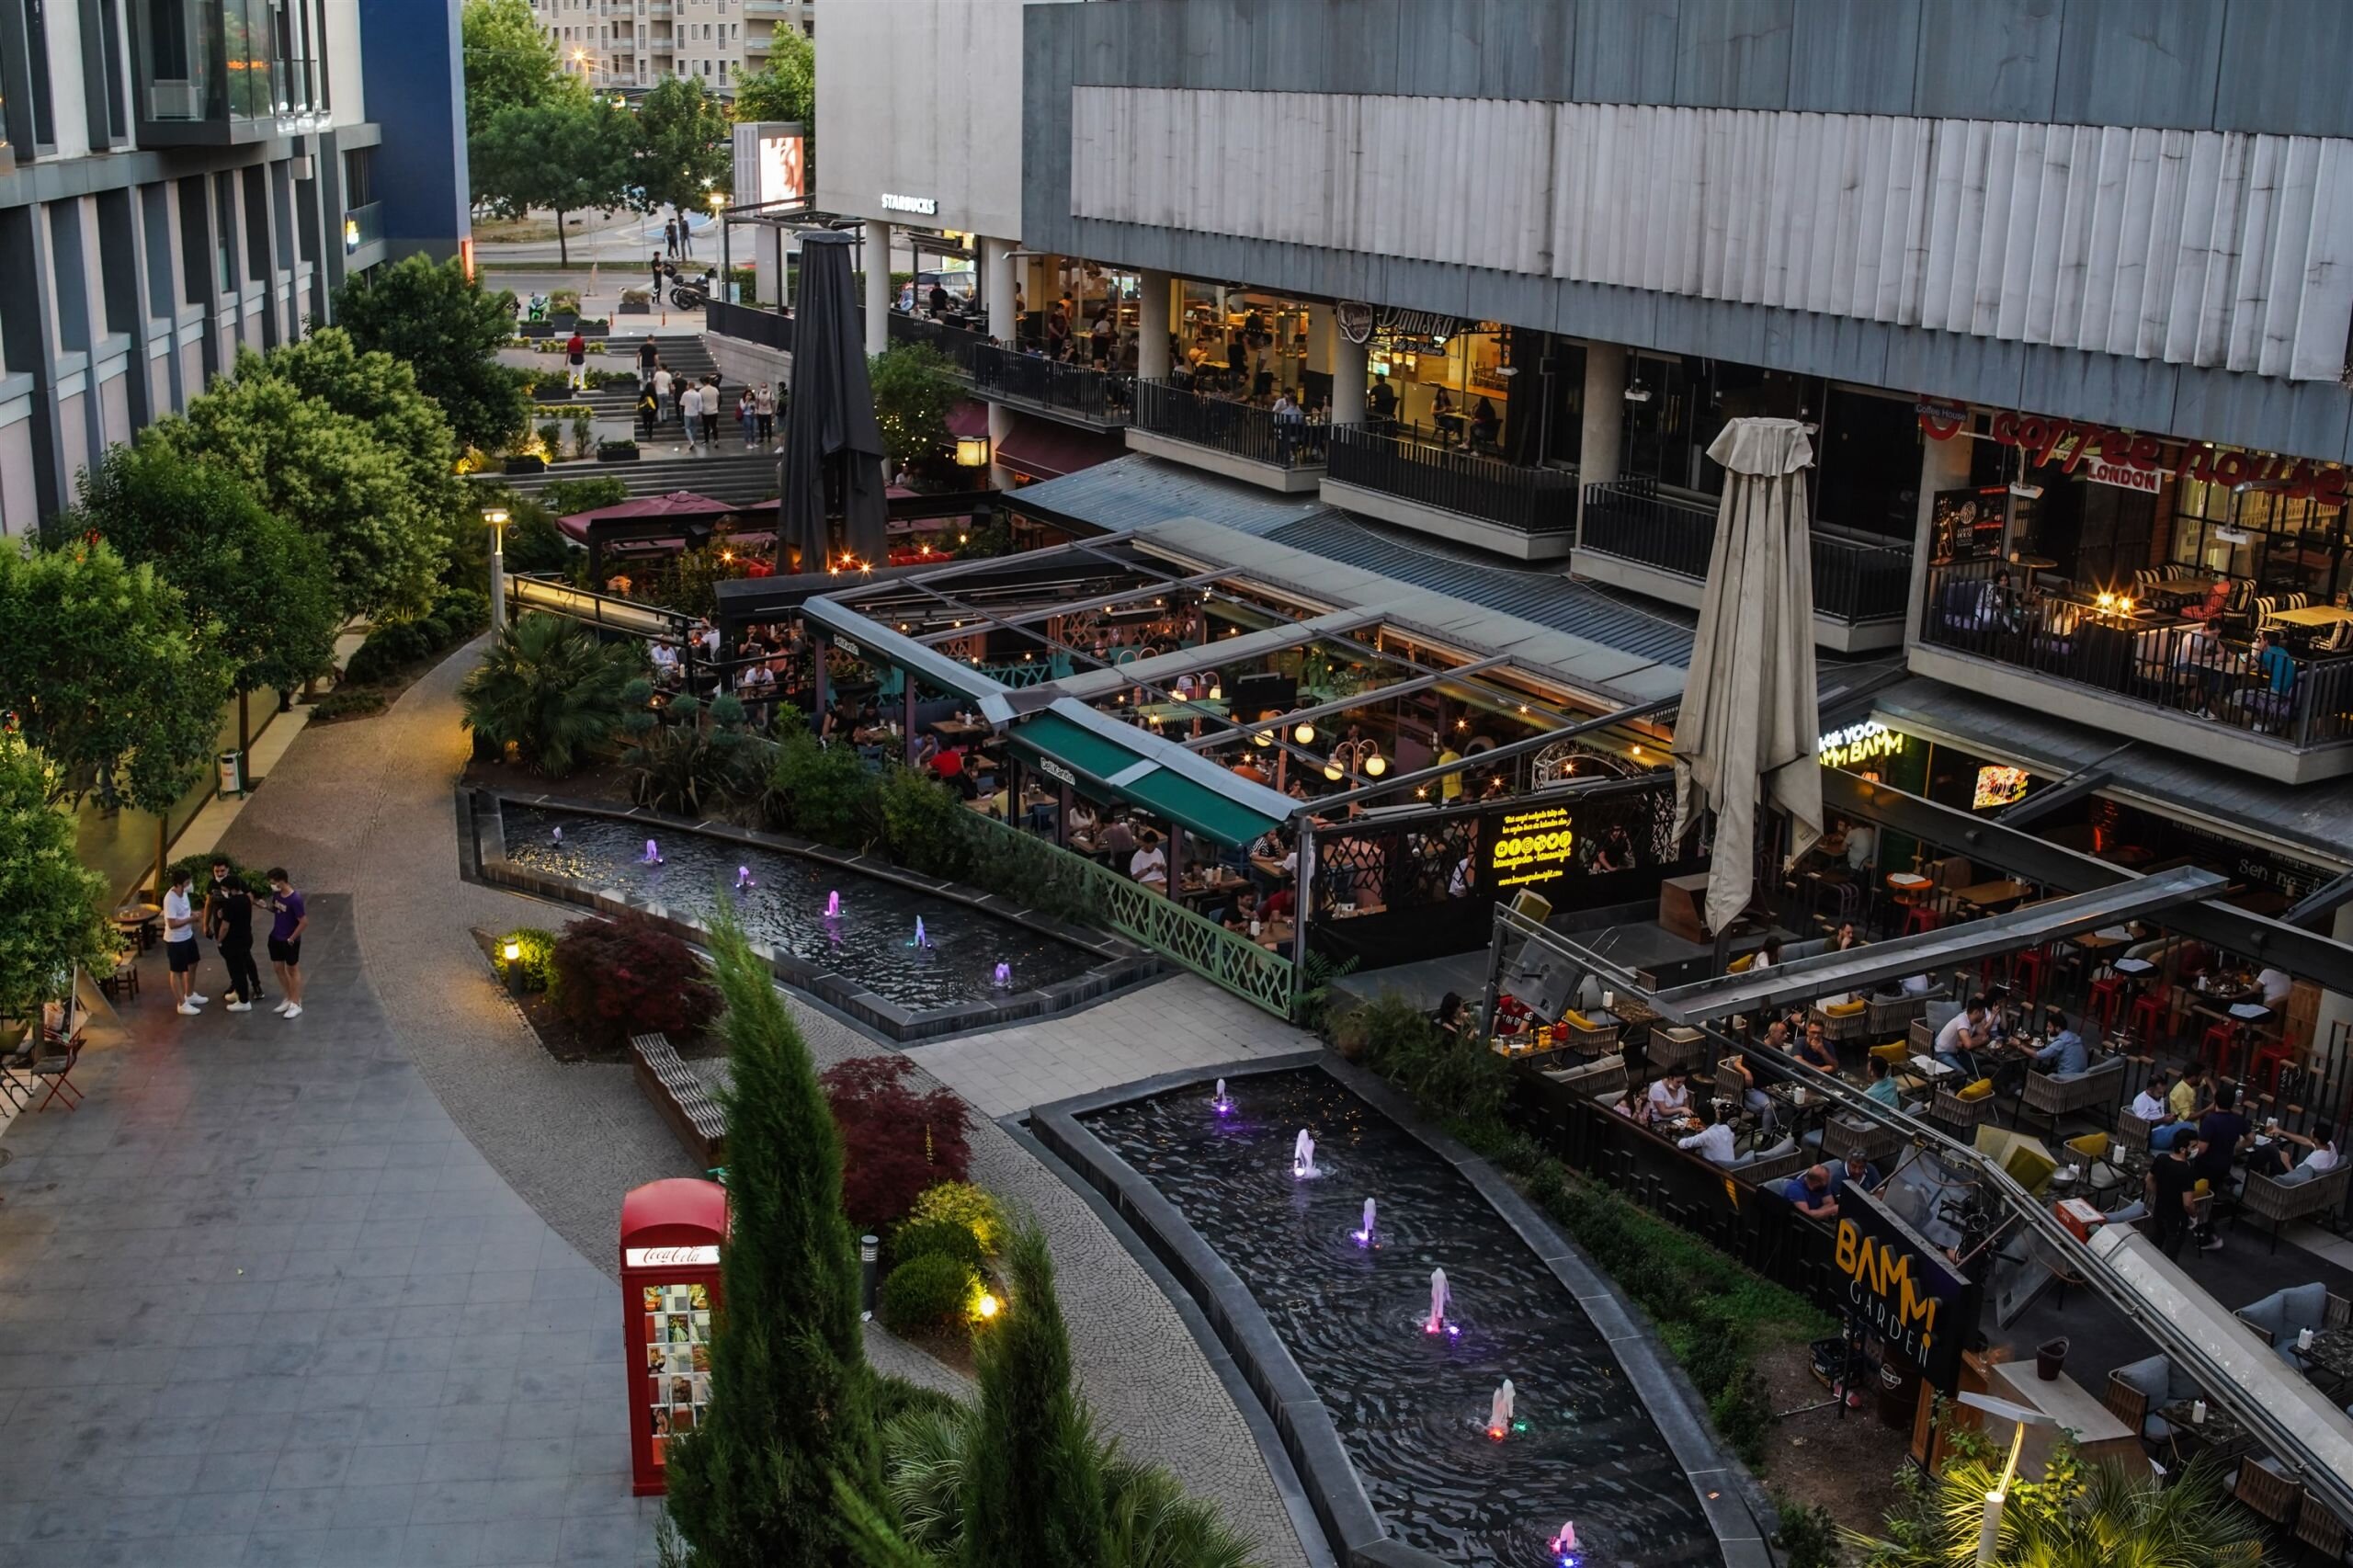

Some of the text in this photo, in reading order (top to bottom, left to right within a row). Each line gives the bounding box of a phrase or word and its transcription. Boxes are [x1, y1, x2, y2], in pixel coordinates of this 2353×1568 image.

[881, 193, 936, 215] STARBUCKS
[1915, 403, 1966, 421] Coffee House
[2088, 461, 2155, 491] LONDON
[1850, 729, 1904, 763] BAMM!
[1836, 1218, 1939, 1348] BAMM!
[1850, 1279, 1929, 1368] GARDEN
